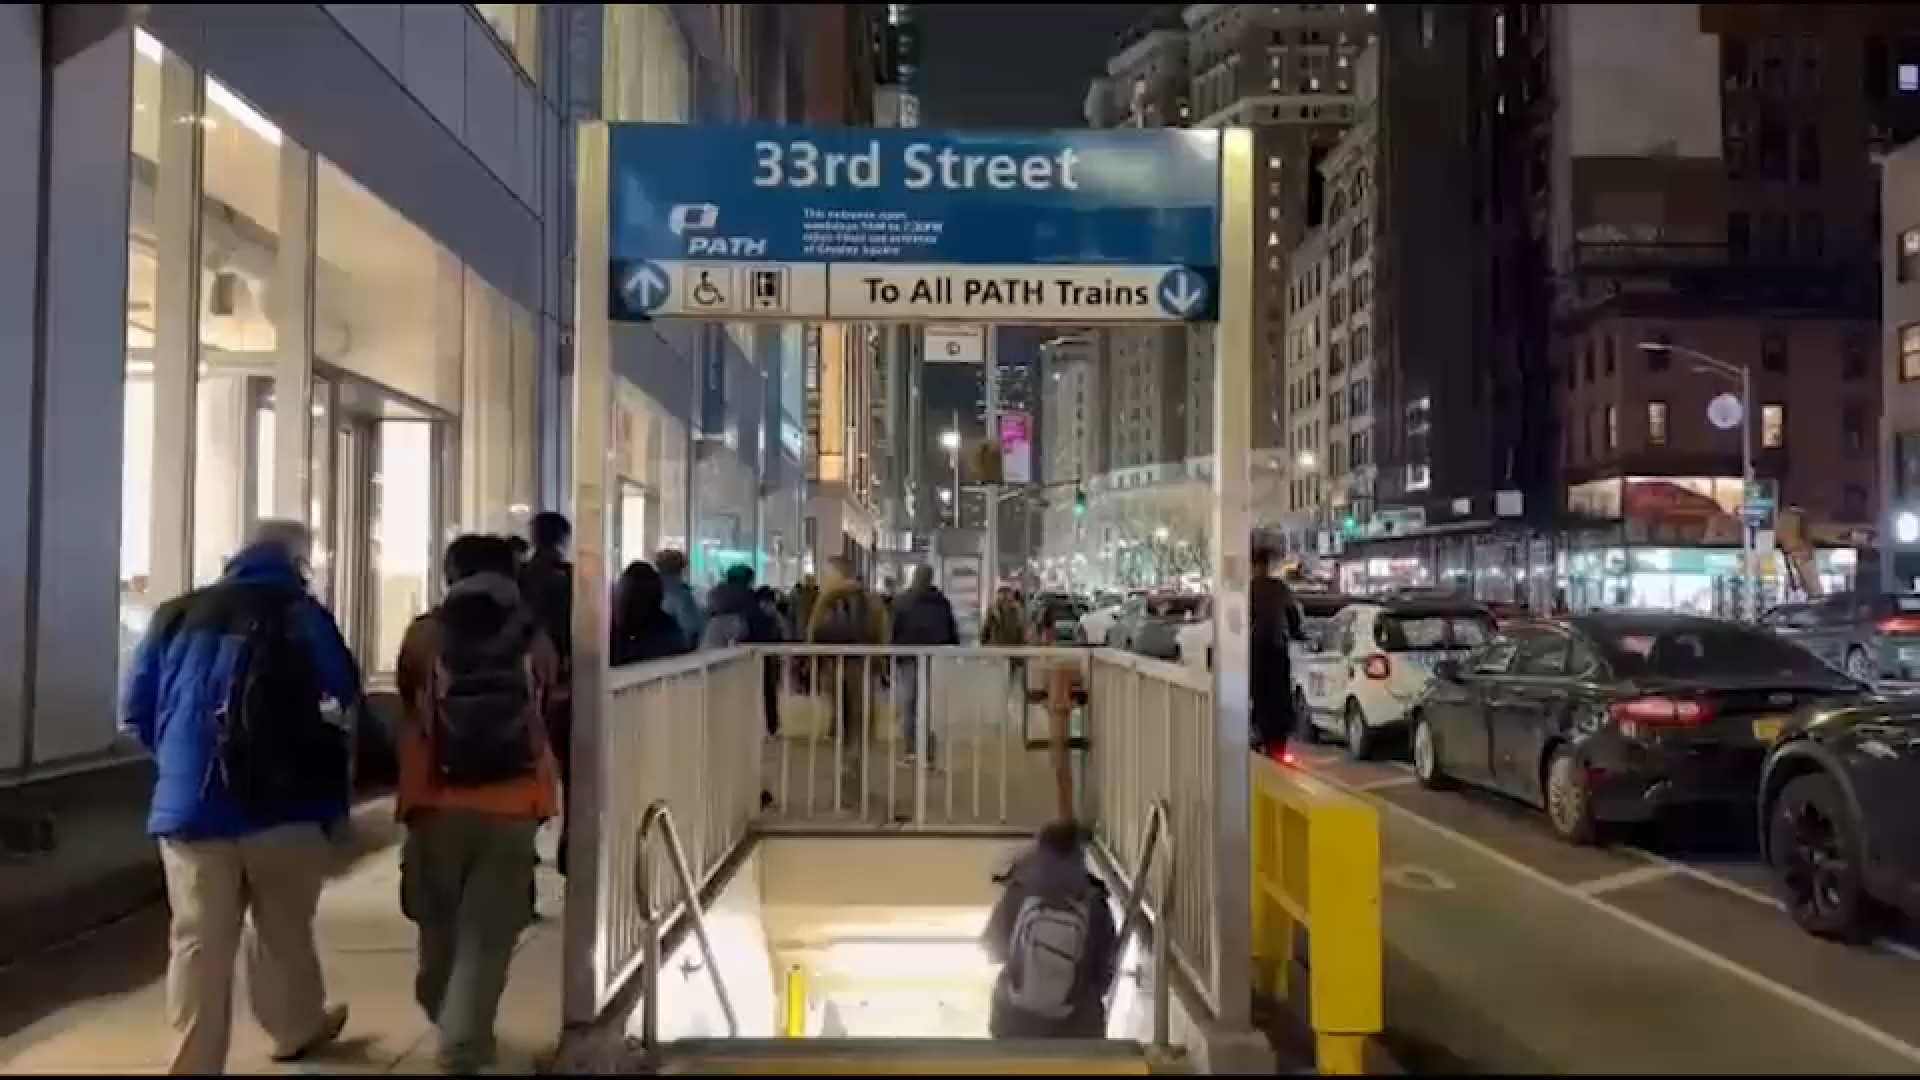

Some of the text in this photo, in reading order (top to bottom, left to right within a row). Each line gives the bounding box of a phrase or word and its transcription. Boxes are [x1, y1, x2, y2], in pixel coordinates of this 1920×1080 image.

[752, 139, 1079, 190] 33rd Street
[687, 237, 768, 256] PATH
[863, 275, 1149, 306] To All PATH Trains
